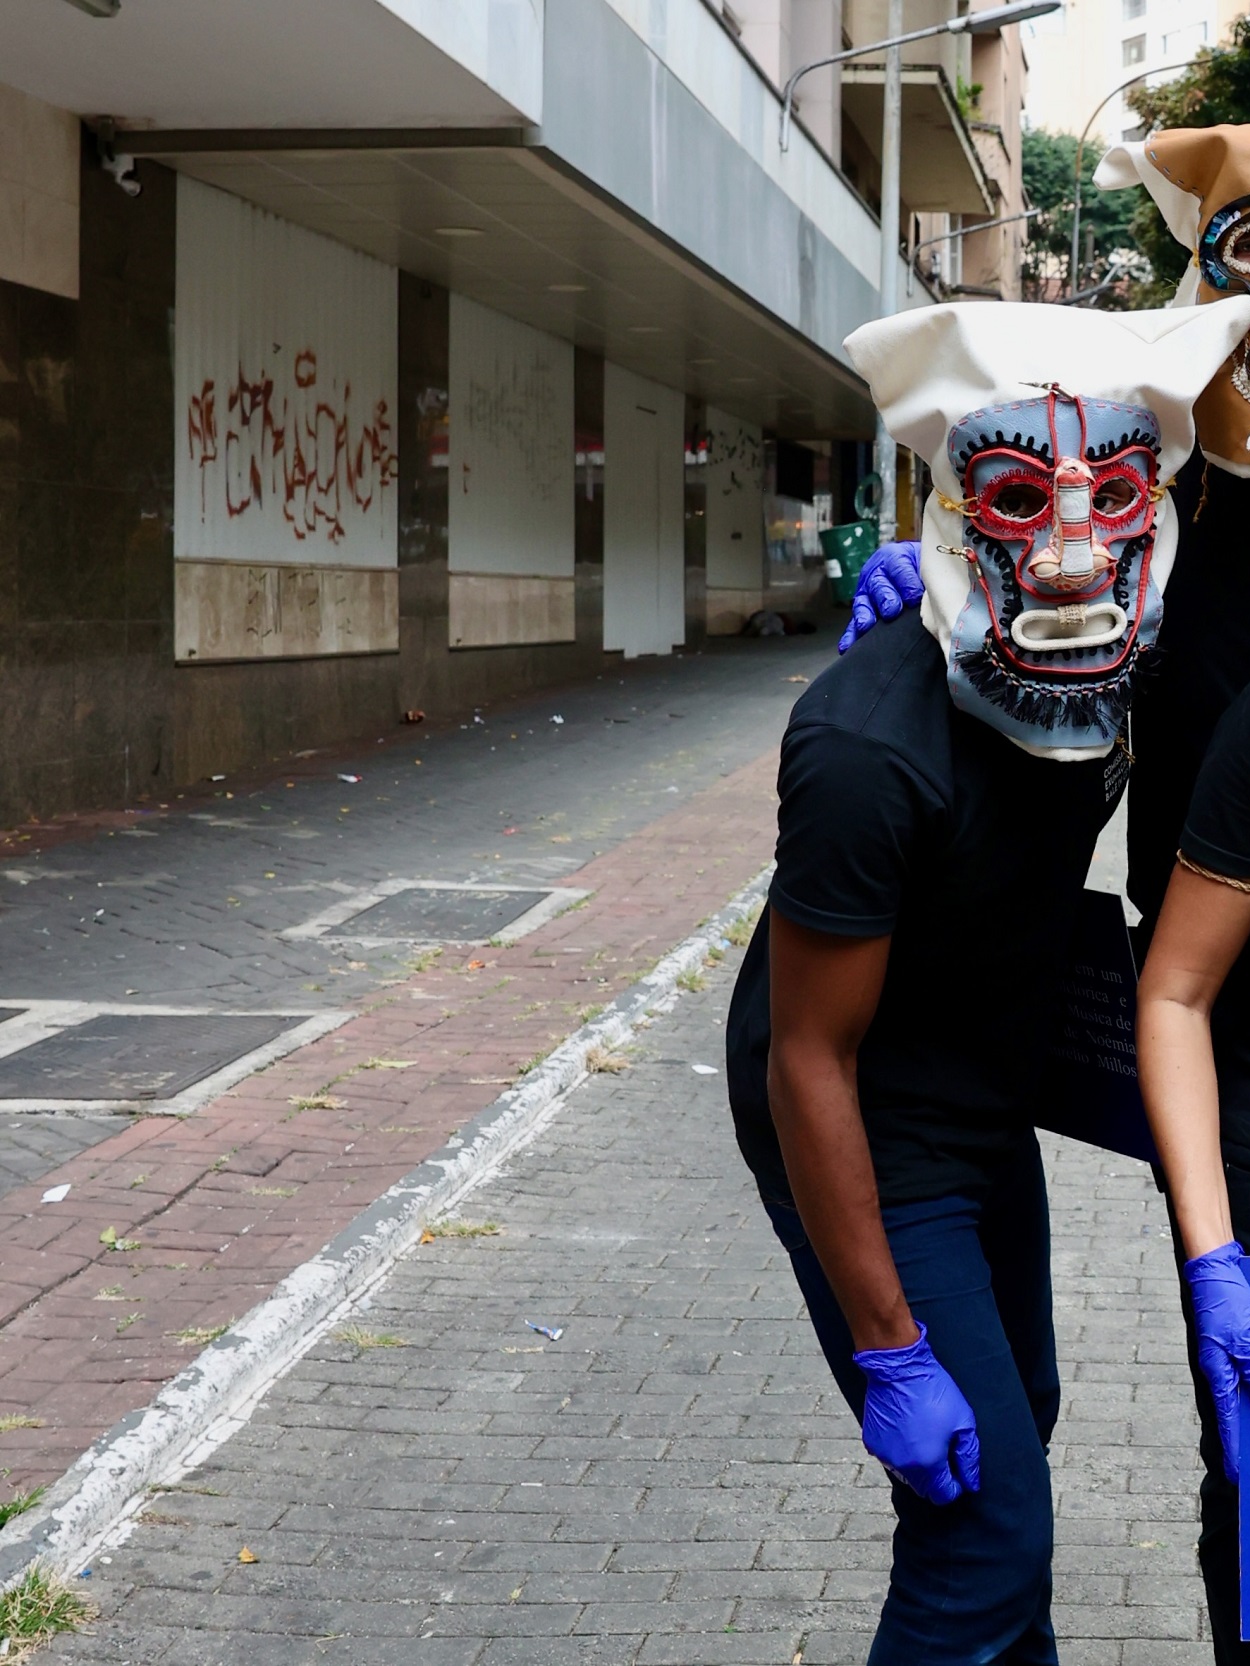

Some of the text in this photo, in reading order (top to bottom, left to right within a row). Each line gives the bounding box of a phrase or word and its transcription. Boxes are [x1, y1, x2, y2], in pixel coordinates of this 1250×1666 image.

[1074, 964, 1123, 984] em um
[1119, 996, 1127, 1008] e
[1115, 1014, 1132, 1032] de
